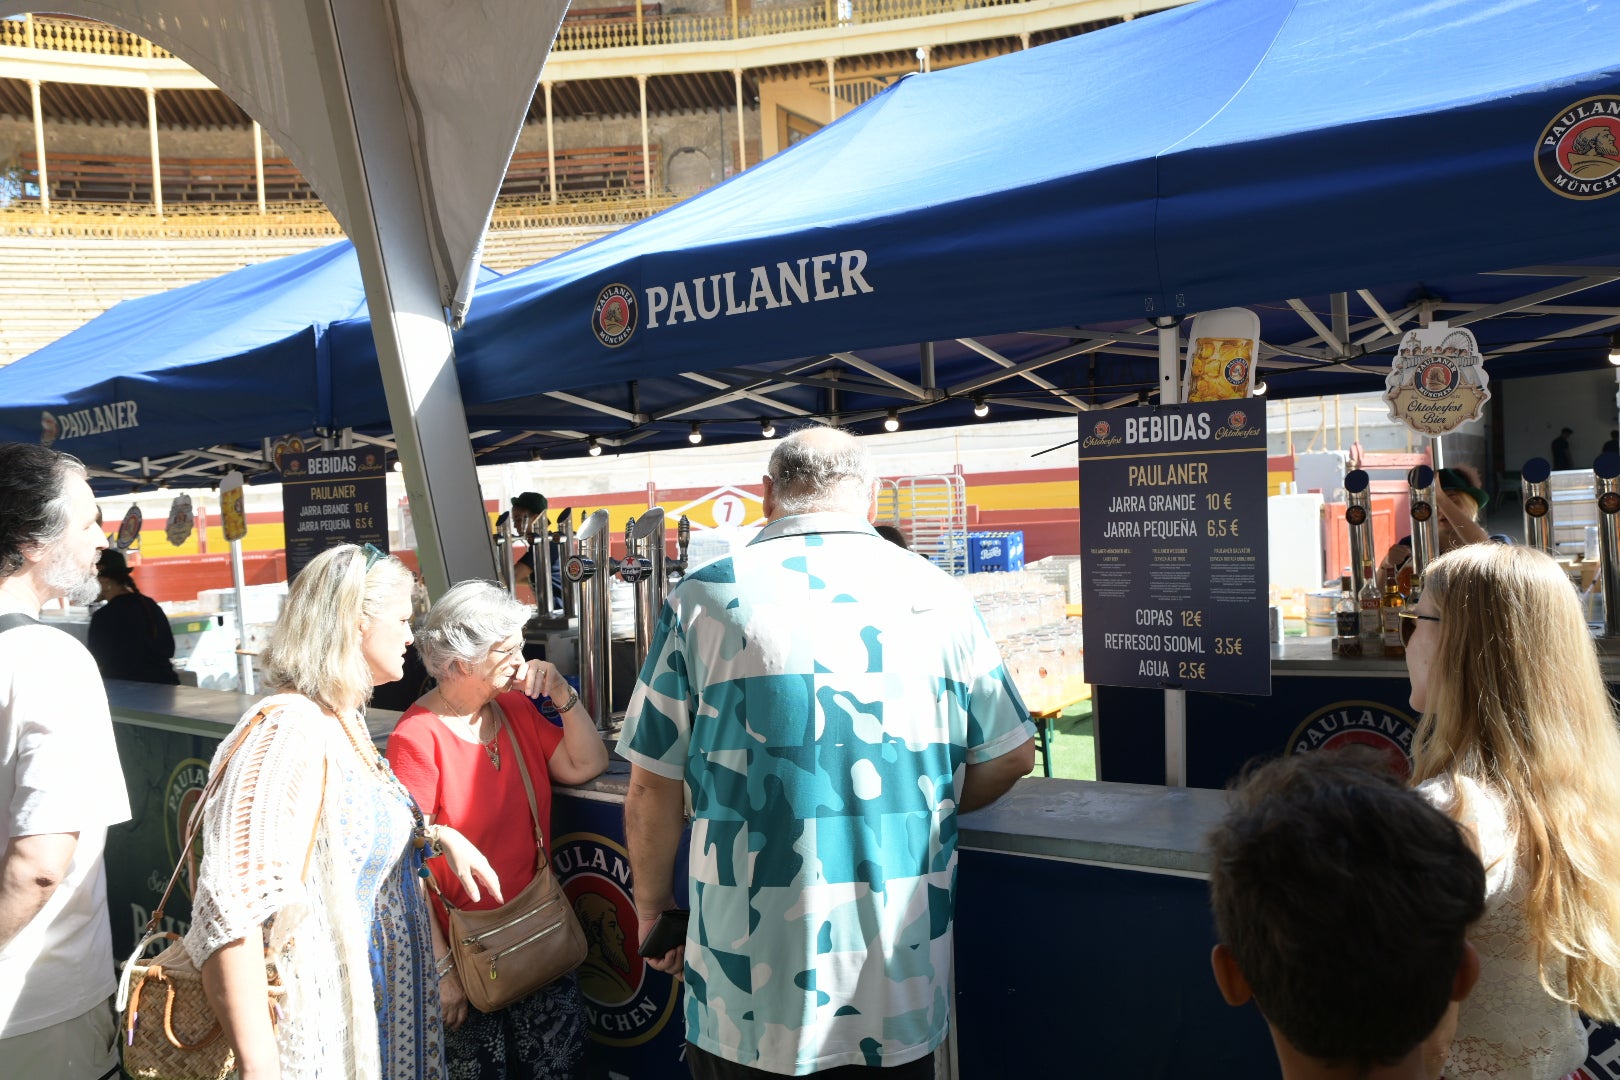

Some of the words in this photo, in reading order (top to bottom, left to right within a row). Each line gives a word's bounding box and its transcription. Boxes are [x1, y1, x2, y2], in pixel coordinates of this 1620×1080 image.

[1544, 101, 1620, 146] PAULAN
[1554, 174, 1620, 193] MÜNCH
[596, 286, 633, 312] PAULANER
[645, 249, 874, 329] PAULANER
[1407, 399, 1463, 415] Oktoberfest
[1421, 411, 1447, 424] Bier
[58, 400, 139, 440] PAULANER
[1125, 412, 1211, 444] BEBIDAS
[307, 455, 357, 475] BEBIDAS
[1128, 462, 1209, 487] PAULANER
[310, 484, 356, 500] PAULANER
[299, 504, 322, 517] JARRA
[322, 503, 350, 515] GRANDE
[723, 502, 733, 522] 7
[1108, 496, 1146, 513] JARRA
[1149, 494, 1197, 511] GRANDE
[1206, 493, 1220, 511] 10
[297, 520, 319, 532] JARRA
[320, 517, 351, 532] PEQUEÑA
[1103, 521, 1141, 538] JARRA
[1143, 517, 1198, 540] PEQUEÑA
[1135, 608, 1173, 626] COPAS
[1181, 610, 1202, 627] 12€
[1104, 633, 1161, 651] REFRESCO
[1163, 634, 1206, 654] 500ML
[1138, 659, 1170, 678] AGUA
[1296, 710, 1414, 757] PAULANE
[168, 768, 205, 815] PAULA
[554, 846, 631, 885] ULAN
[588, 995, 658, 1032] NCHEN
